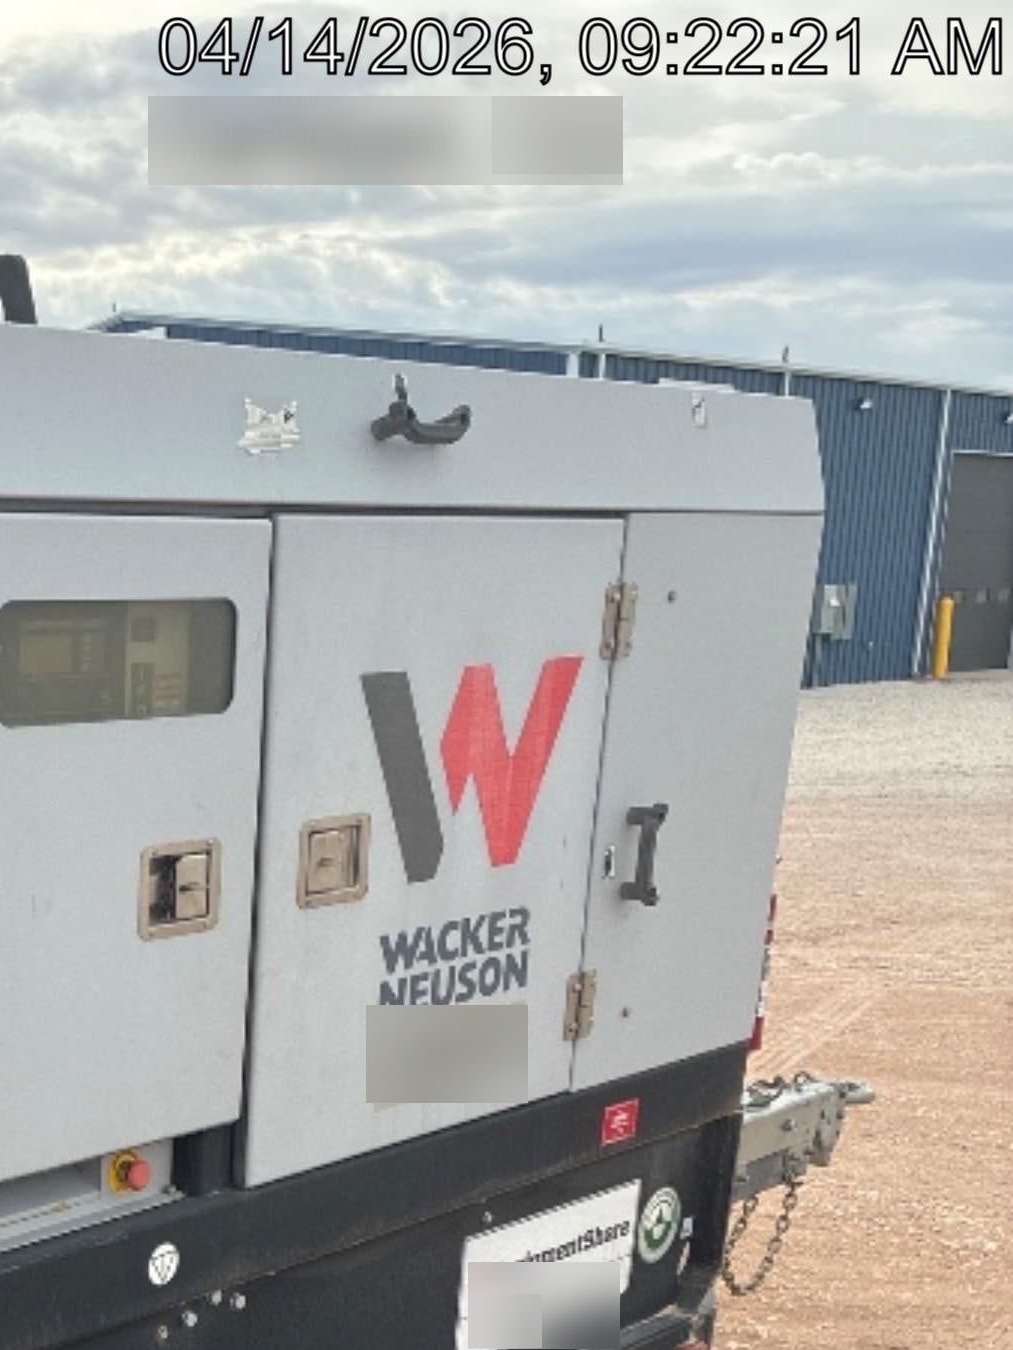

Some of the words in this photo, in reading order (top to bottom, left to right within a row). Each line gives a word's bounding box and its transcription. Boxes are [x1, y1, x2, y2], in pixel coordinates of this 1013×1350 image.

[361, 656, 584, 884] W
[379, 906, 531, 975] WACKER
[379, 950, 529, 1006] NEUSON
